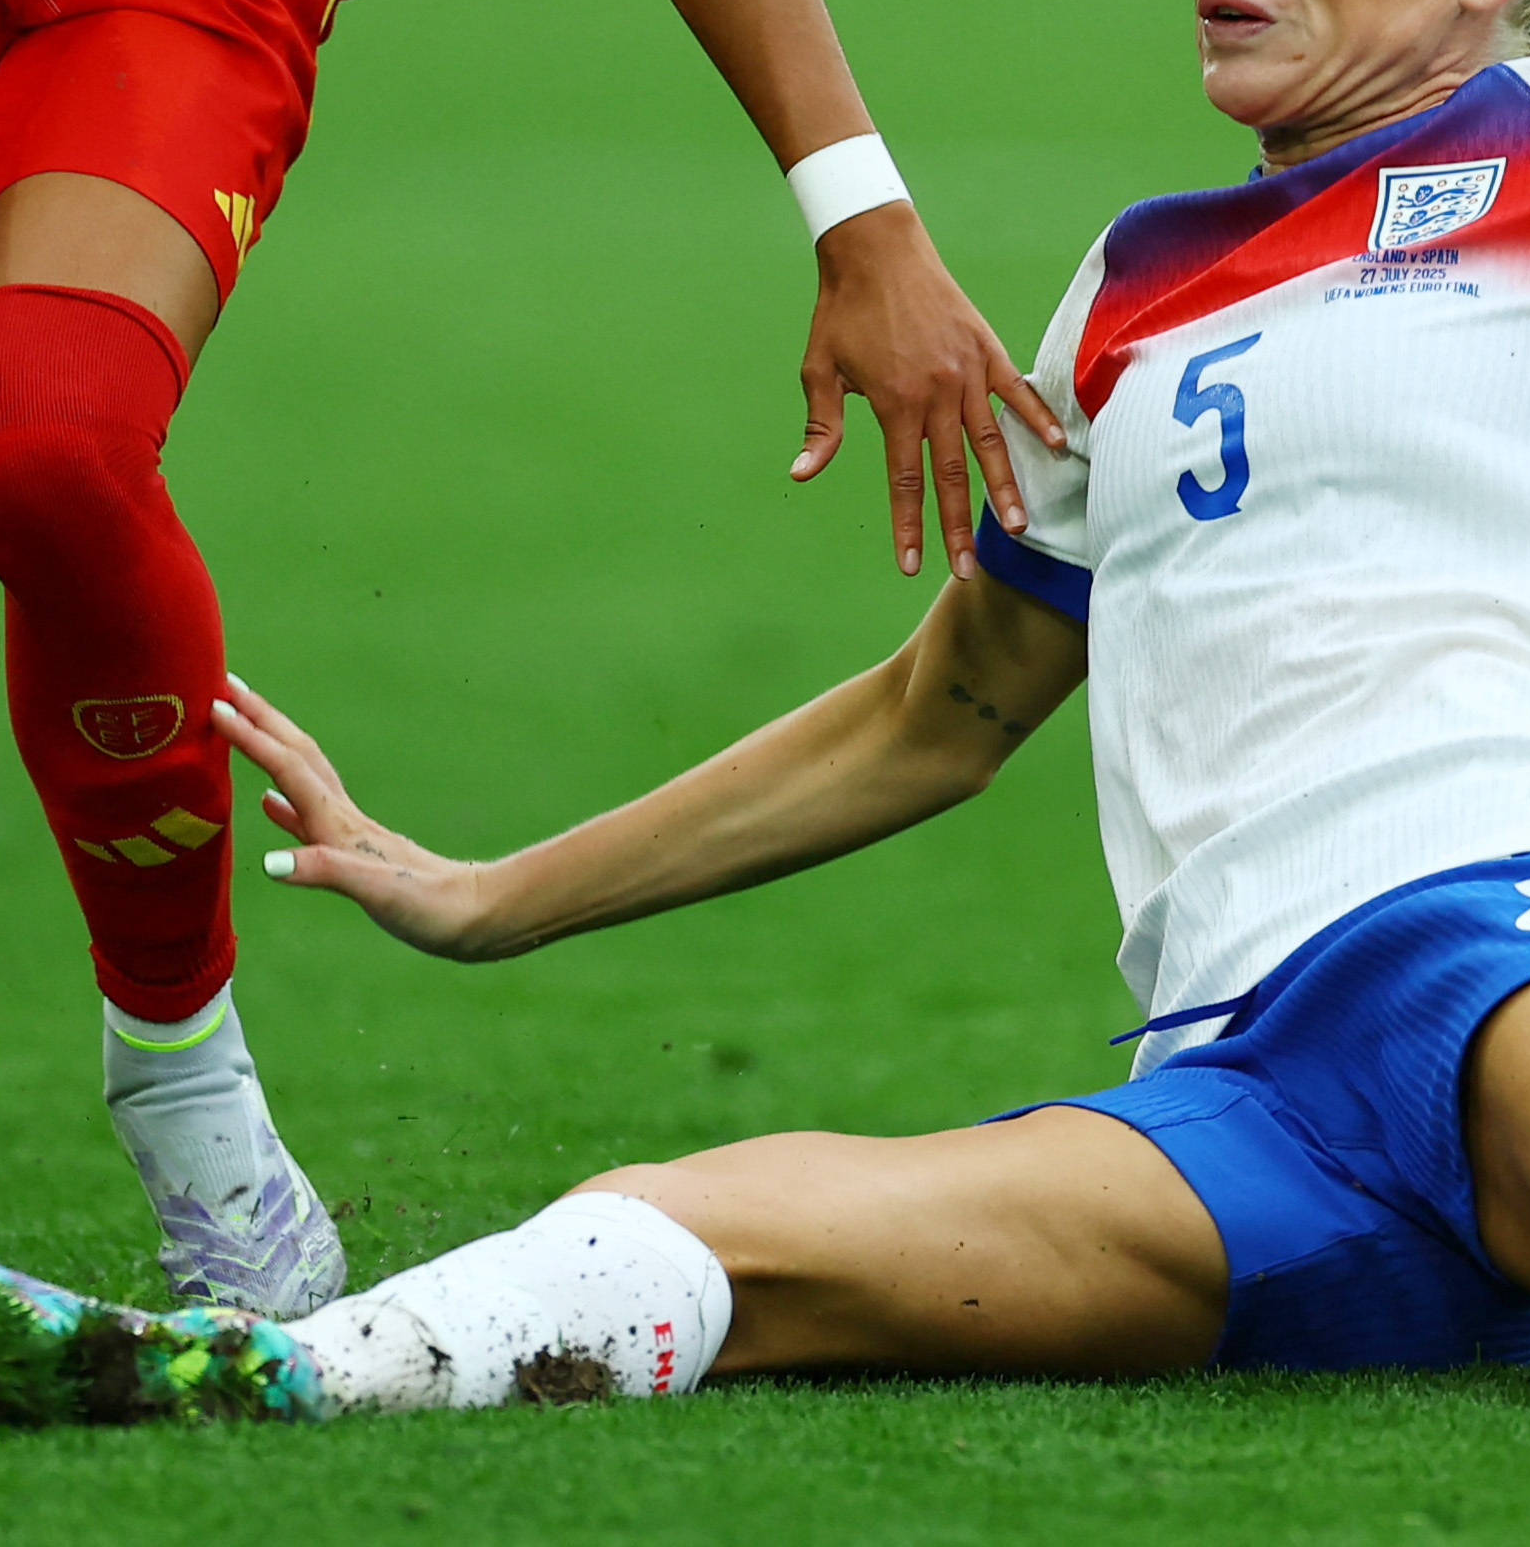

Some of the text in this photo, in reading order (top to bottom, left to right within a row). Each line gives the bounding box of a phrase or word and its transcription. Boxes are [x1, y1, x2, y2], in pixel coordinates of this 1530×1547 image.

[1411, 252, 1417, 264] v
[1421, 249, 1460, 265] SPAIN
[1360, 267, 1447, 285] 27 JULY 2025
[1324, 280, 1482, 304] UEFA WOMENS EURO FINAL
[1172, 330, 1263, 521] 5
